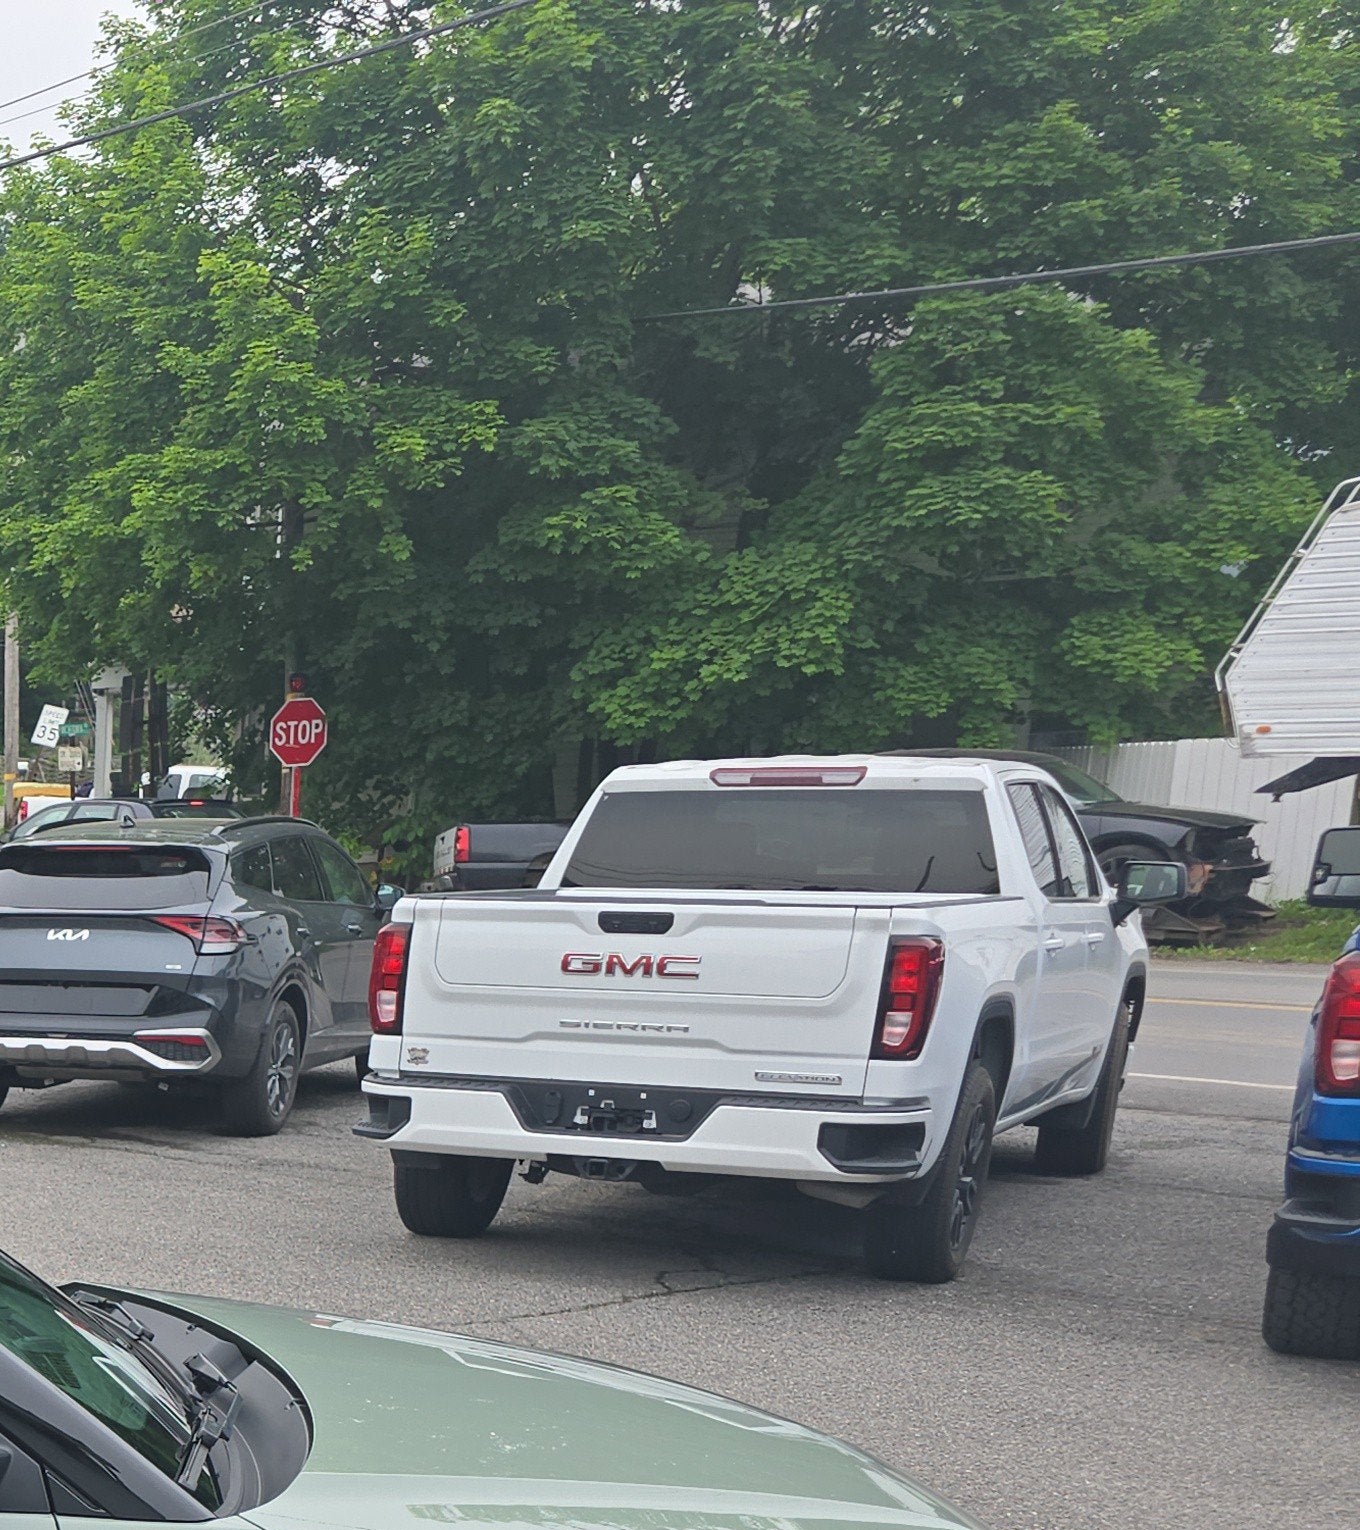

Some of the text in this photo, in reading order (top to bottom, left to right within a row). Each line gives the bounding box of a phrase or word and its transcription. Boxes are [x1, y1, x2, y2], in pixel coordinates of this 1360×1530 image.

[36, 725, 59, 741] 35
[274, 718, 324, 747] STOP
[46, 928, 89, 941] KIA
[561, 951, 702, 979] GMC
[559, 1019, 689, 1033] SIERRA
